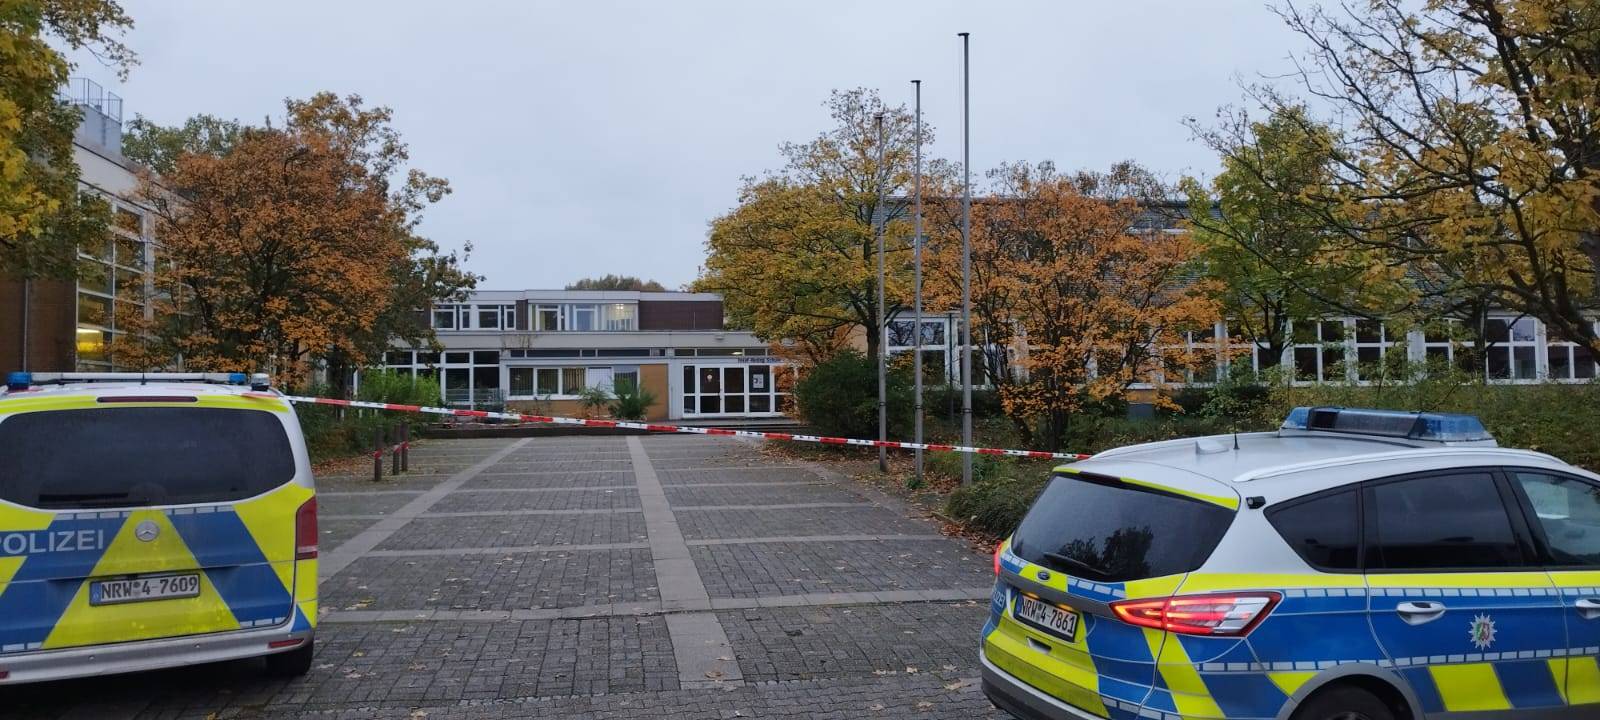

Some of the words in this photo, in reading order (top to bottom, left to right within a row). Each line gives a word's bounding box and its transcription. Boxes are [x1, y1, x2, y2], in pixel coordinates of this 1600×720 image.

[0, 529, 104, 555] OLIZEI
[101, 581, 132, 599] NRW
[142, 576, 198, 595] 4-7609
[1021, 599, 1037, 618] NRW
[1041, 605, 1074, 634] 4-7861
